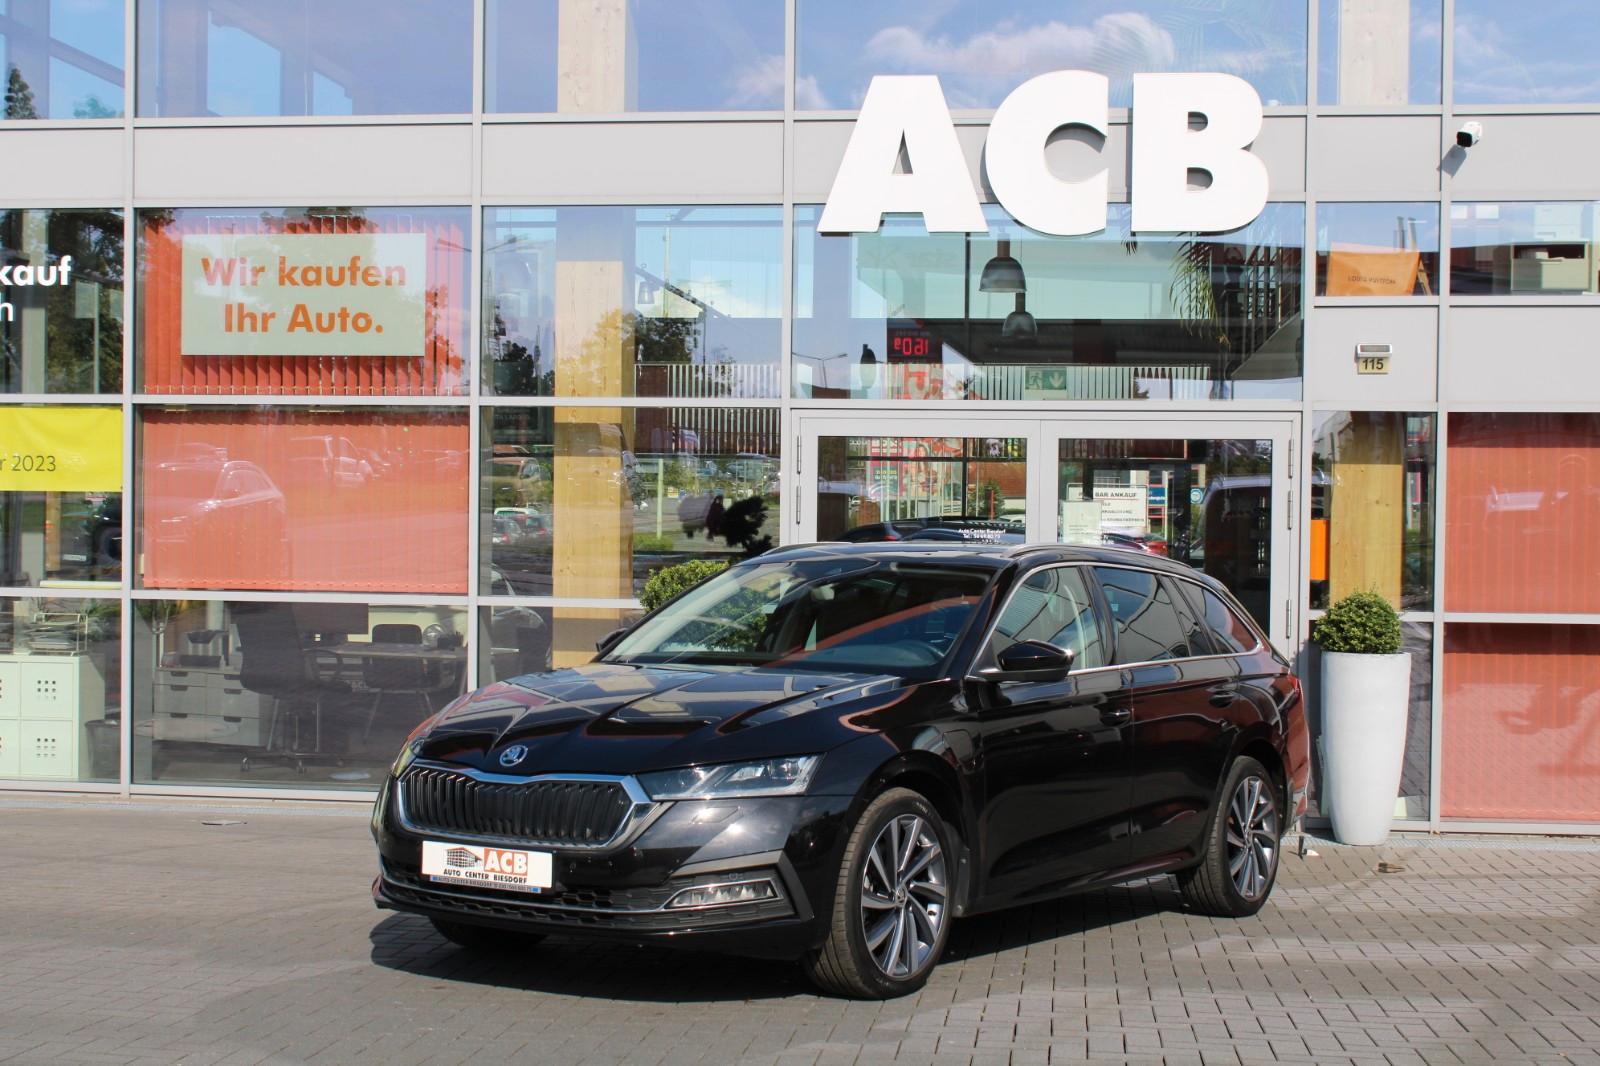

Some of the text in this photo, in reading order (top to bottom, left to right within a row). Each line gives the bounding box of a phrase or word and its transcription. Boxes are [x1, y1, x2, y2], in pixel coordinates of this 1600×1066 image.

[817, 70, 1270, 236] ACB
[201, 255, 406, 287] Wir kaufen
[224, 303, 384, 333] Ihr Auto.
[1362, 358, 1384, 370] 115
[12, 455, 56, 472] 2023
[484, 849, 528, 875] ACB
[443, 868, 528, 884] AUTO CENTER BIESDORF
